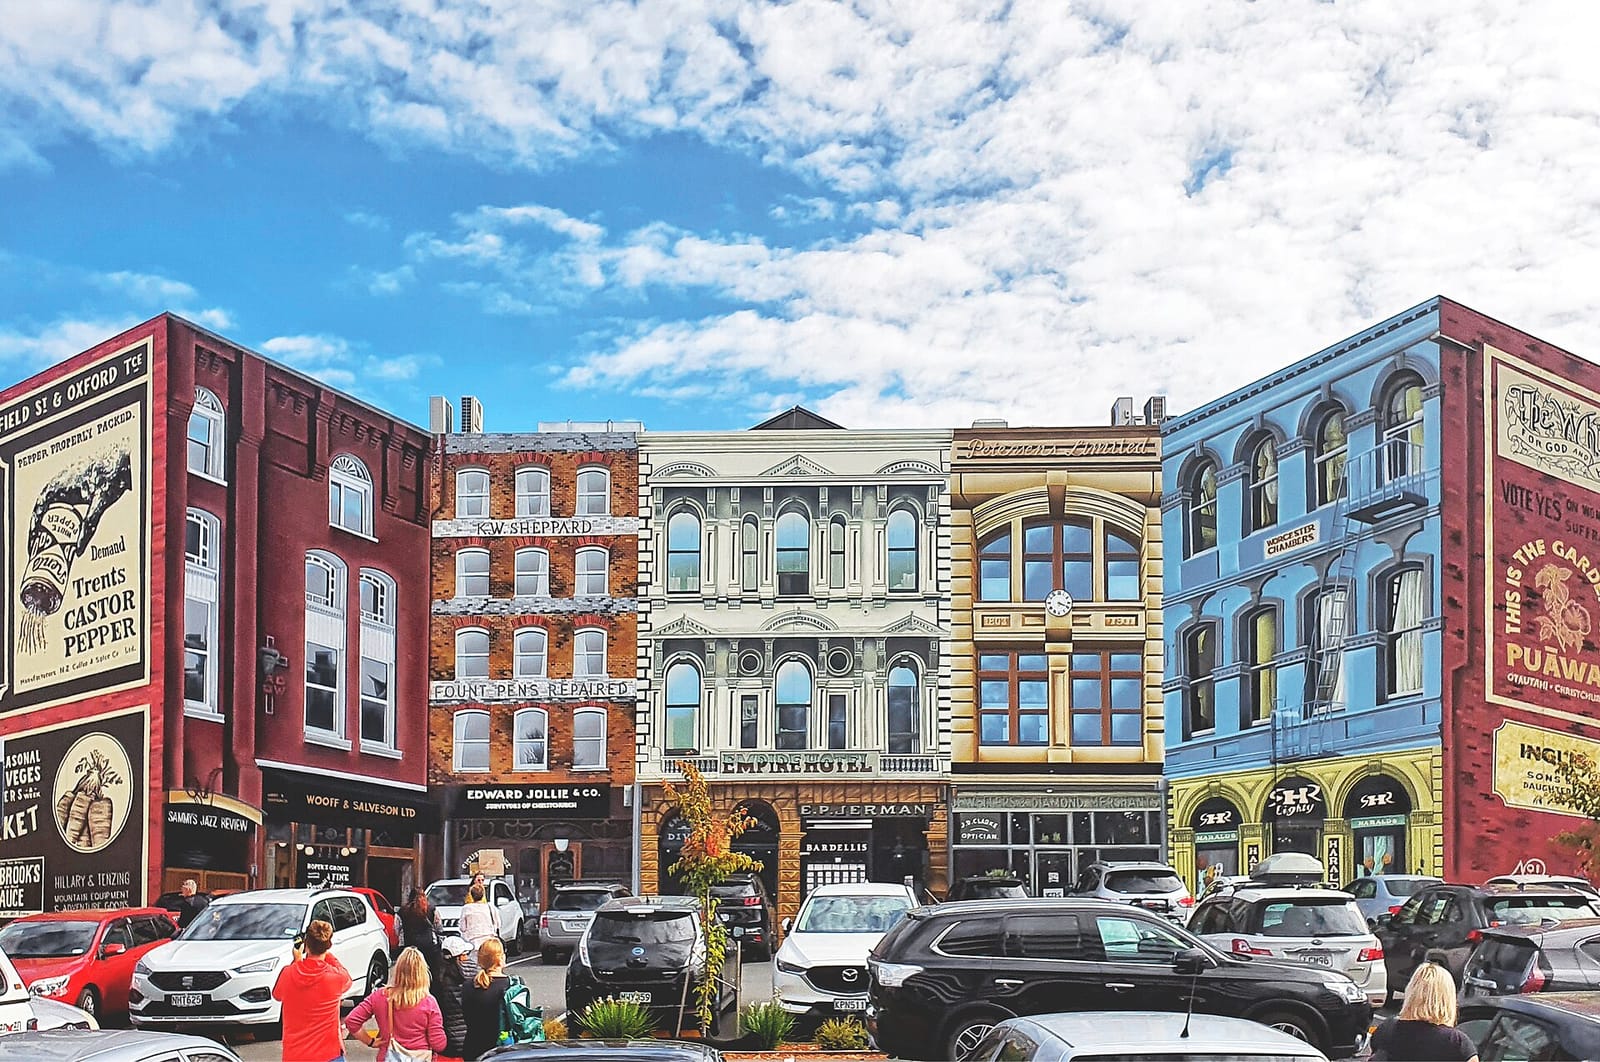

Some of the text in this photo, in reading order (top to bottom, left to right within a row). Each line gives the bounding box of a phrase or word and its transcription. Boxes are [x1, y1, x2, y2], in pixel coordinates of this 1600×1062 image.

[52, 392, 62, 408] &
[67, 366, 118, 401] OXFORD
[18, 410, 136, 468] PEPPER PROPERLY PACKED.
[1546, 440, 1568, 454] GOD
[1572, 448, 1589, 461] AND
[1500, 479, 1534, 513] VOTE
[1536, 492, 1562, 522] YES
[1566, 498, 1578, 513] ON
[510, 520, 592, 534] SHEPPARD
[1266, 524, 1316, 546] WORCESTER
[90, 535, 126, 562] Demand
[1268, 533, 1314, 554] CHAMBERS
[1512, 538, 1546, 568] THE
[72, 567, 126, 600] Trents
[1506, 566, 1523, 588] IS
[64, 590, 136, 630] CASTOR
[1505, 590, 1521, 634] THIS
[64, 618, 136, 658] PEPPER
[434, 682, 628, 698] FOUNT PENS REPAIRED
[722, 753, 872, 774] EMPIRE HOTEL
[6, 766, 40, 788] VEGES
[1528, 771, 1560, 784] SONS
[467, 788, 600, 799] EDWARD JOLLIE & CO.
[306, 794, 416, 818] WOOFF & SALVESON LTD
[200, 815, 218, 828] JAZZ
[221, 817, 248, 832] REVIEW
[54, 872, 130, 888] HILLARY & TENZING
[54, 890, 129, 902] MOUNTAIN EQUIPMENT
